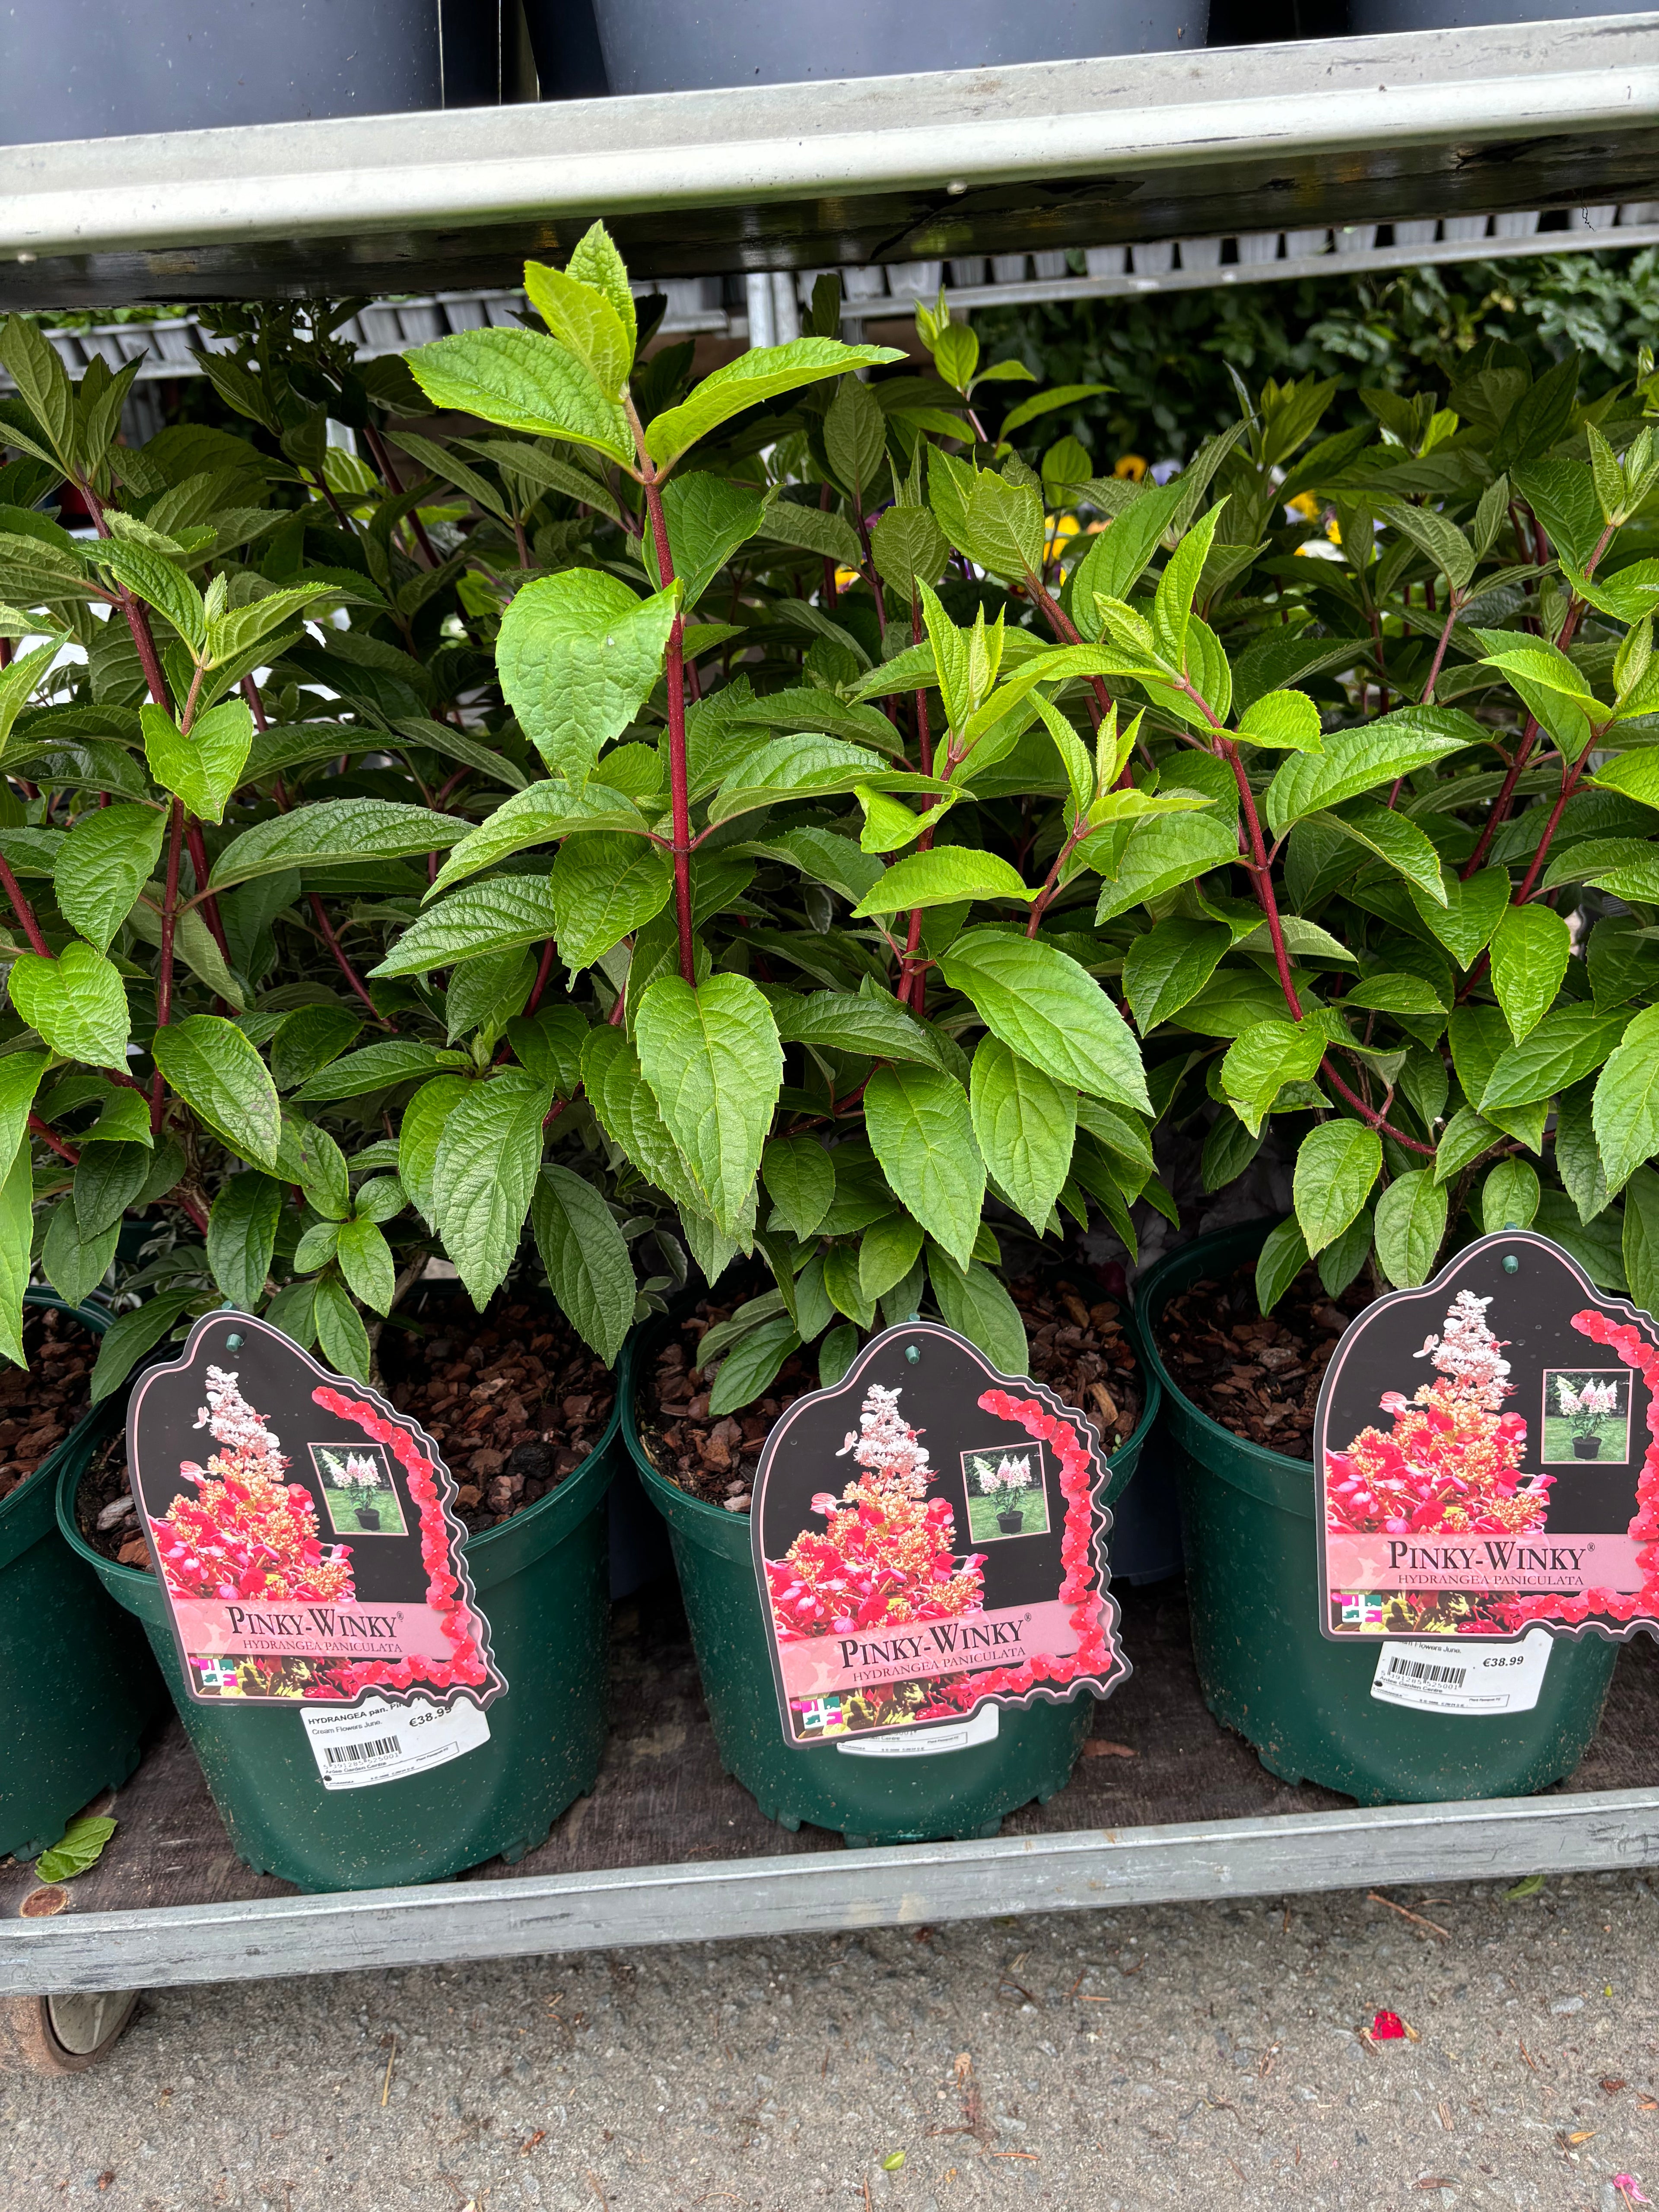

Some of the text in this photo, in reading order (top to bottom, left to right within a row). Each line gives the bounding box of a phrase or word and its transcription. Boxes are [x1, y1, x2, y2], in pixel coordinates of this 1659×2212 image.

[1398, 1575, 1584, 1585] HYDRANGEA PANICULATA
[243, 1640, 403, 1653] HYDRANGEA PANICULATA
[853, 1646, 1026, 1682] HYDRANGEA PANICULATA
[1483, 1656, 1524, 1667] €38.99
[308, 1711, 367, 1725] HYDRANGEA
[369, 1707, 388, 1717] pan.
[409, 1707, 452, 1727] €38.99
